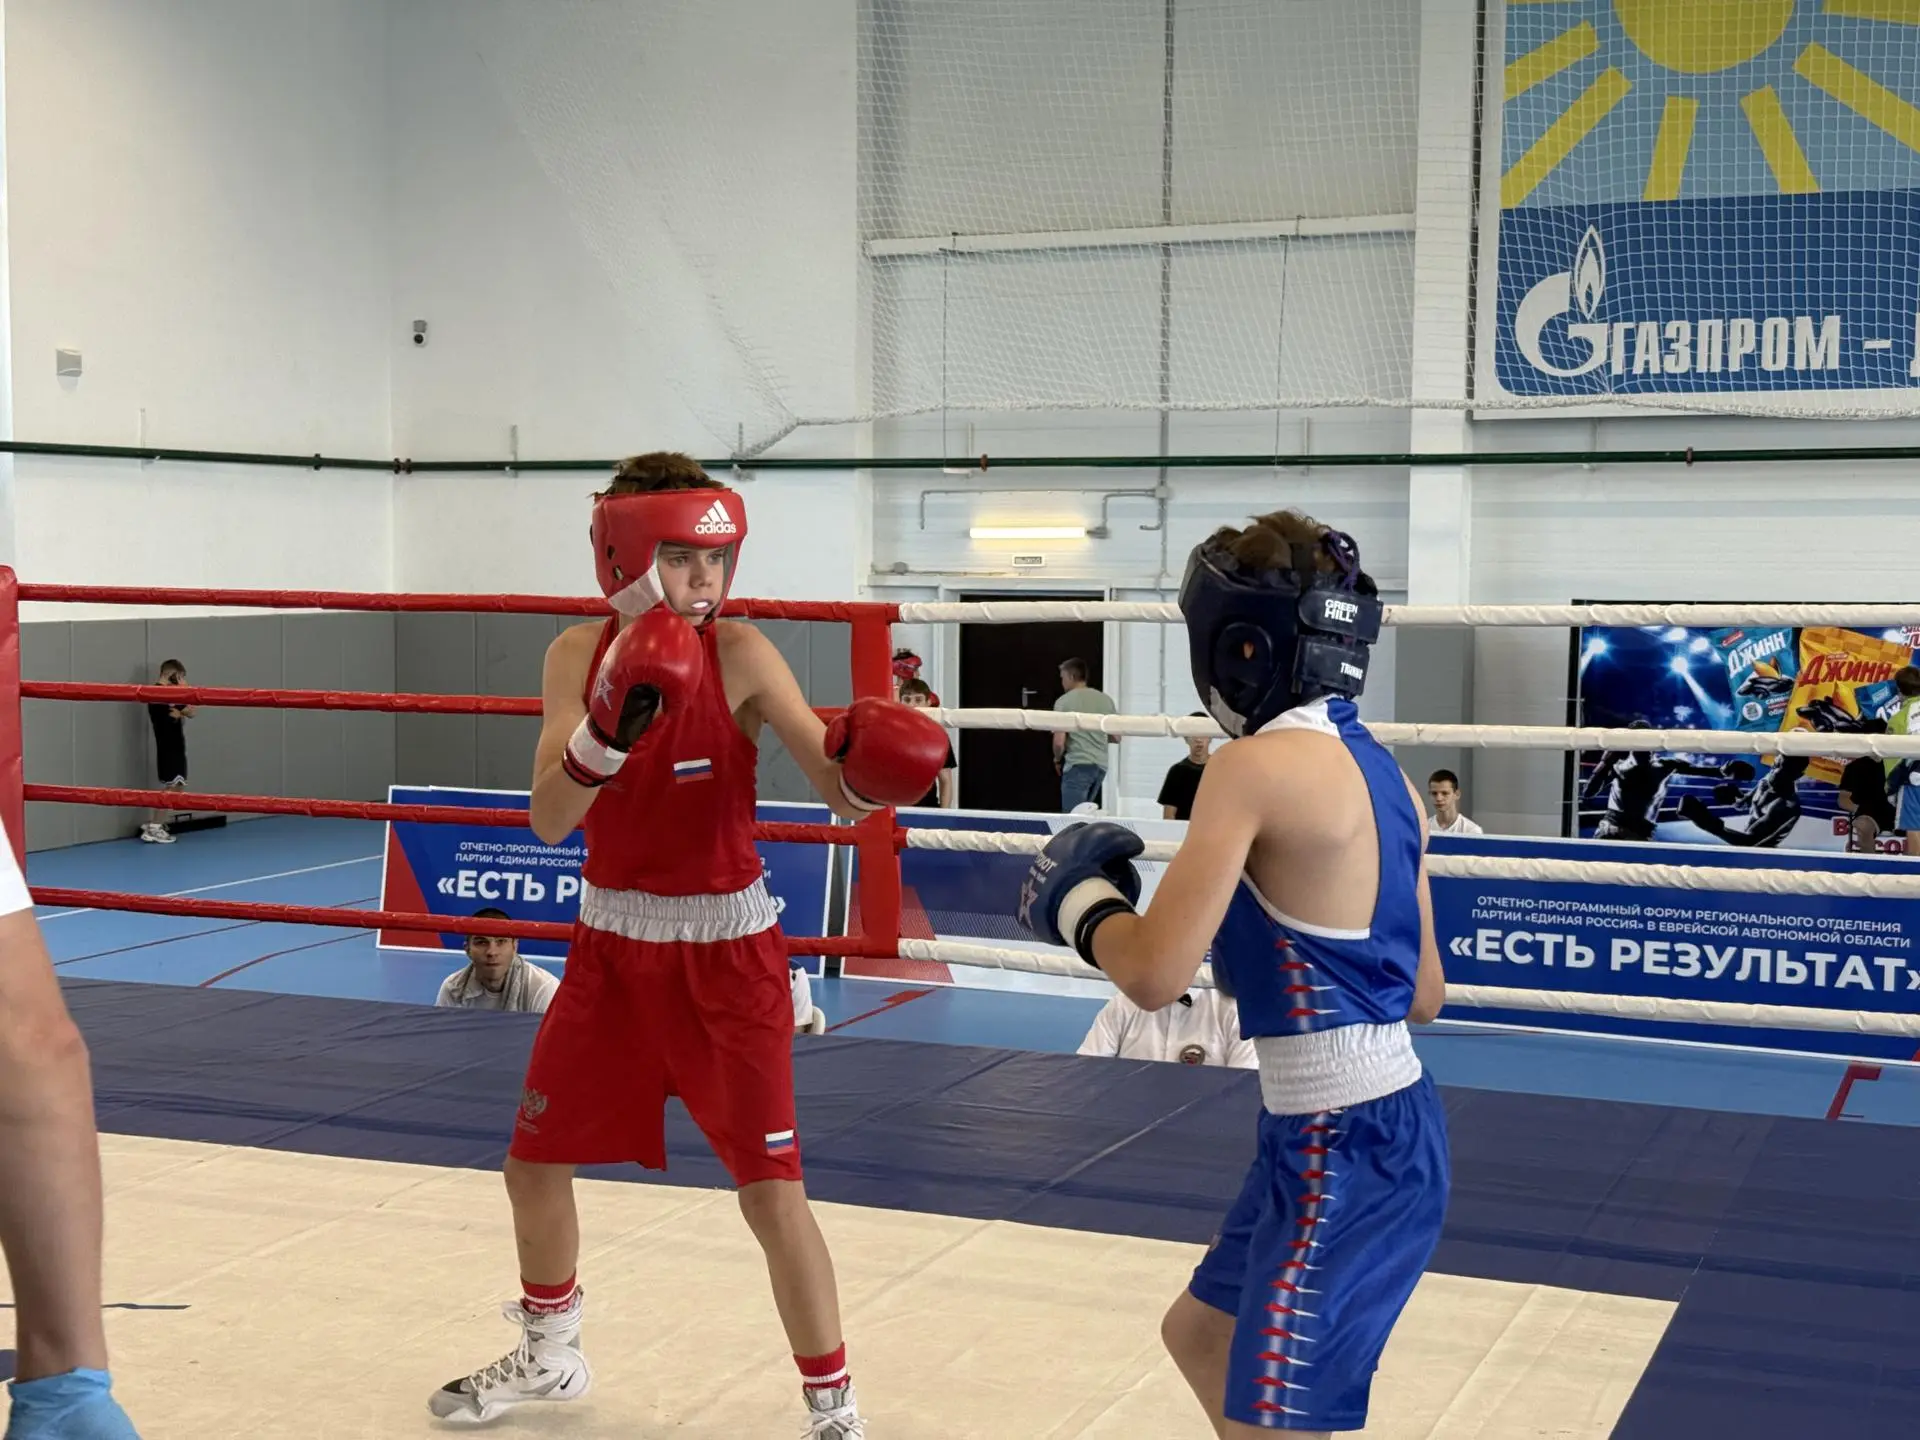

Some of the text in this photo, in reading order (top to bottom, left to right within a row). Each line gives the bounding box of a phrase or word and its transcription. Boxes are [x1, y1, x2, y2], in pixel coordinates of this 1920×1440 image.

[1612, 315, 1841, 376] ГАЗПРОМ
[695, 521, 737, 534] adidas
[1324, 607, 1354, 623] HILL
[1325, 599, 1358, 614] GREEN
[455, 853, 493, 864] ПАРТИИ
[495, 855, 538, 866] «ЕДИНАЯ
[460, 841, 581, 857] ОТЧЕТНО-ПРОГРАММНЫЙ
[437, 870, 546, 902] «ЕСТЬ
[1477, 895, 1901, 933] ОТЧЕТНО-ПРОГРАММНЫЙ ФОРУМ РЕГИОНАЛЬНОГО ОТДЕЛЕНИЯ
[1471, 909, 1911, 948] ПАРТИИ «ЕДИНАЯ РОССИЯ» В ЕВРЕЙСКОЙ АВТОНОМНОЙ ОБЛАСТИ
[1448, 928, 1596, 968] «ЕСТЬ
